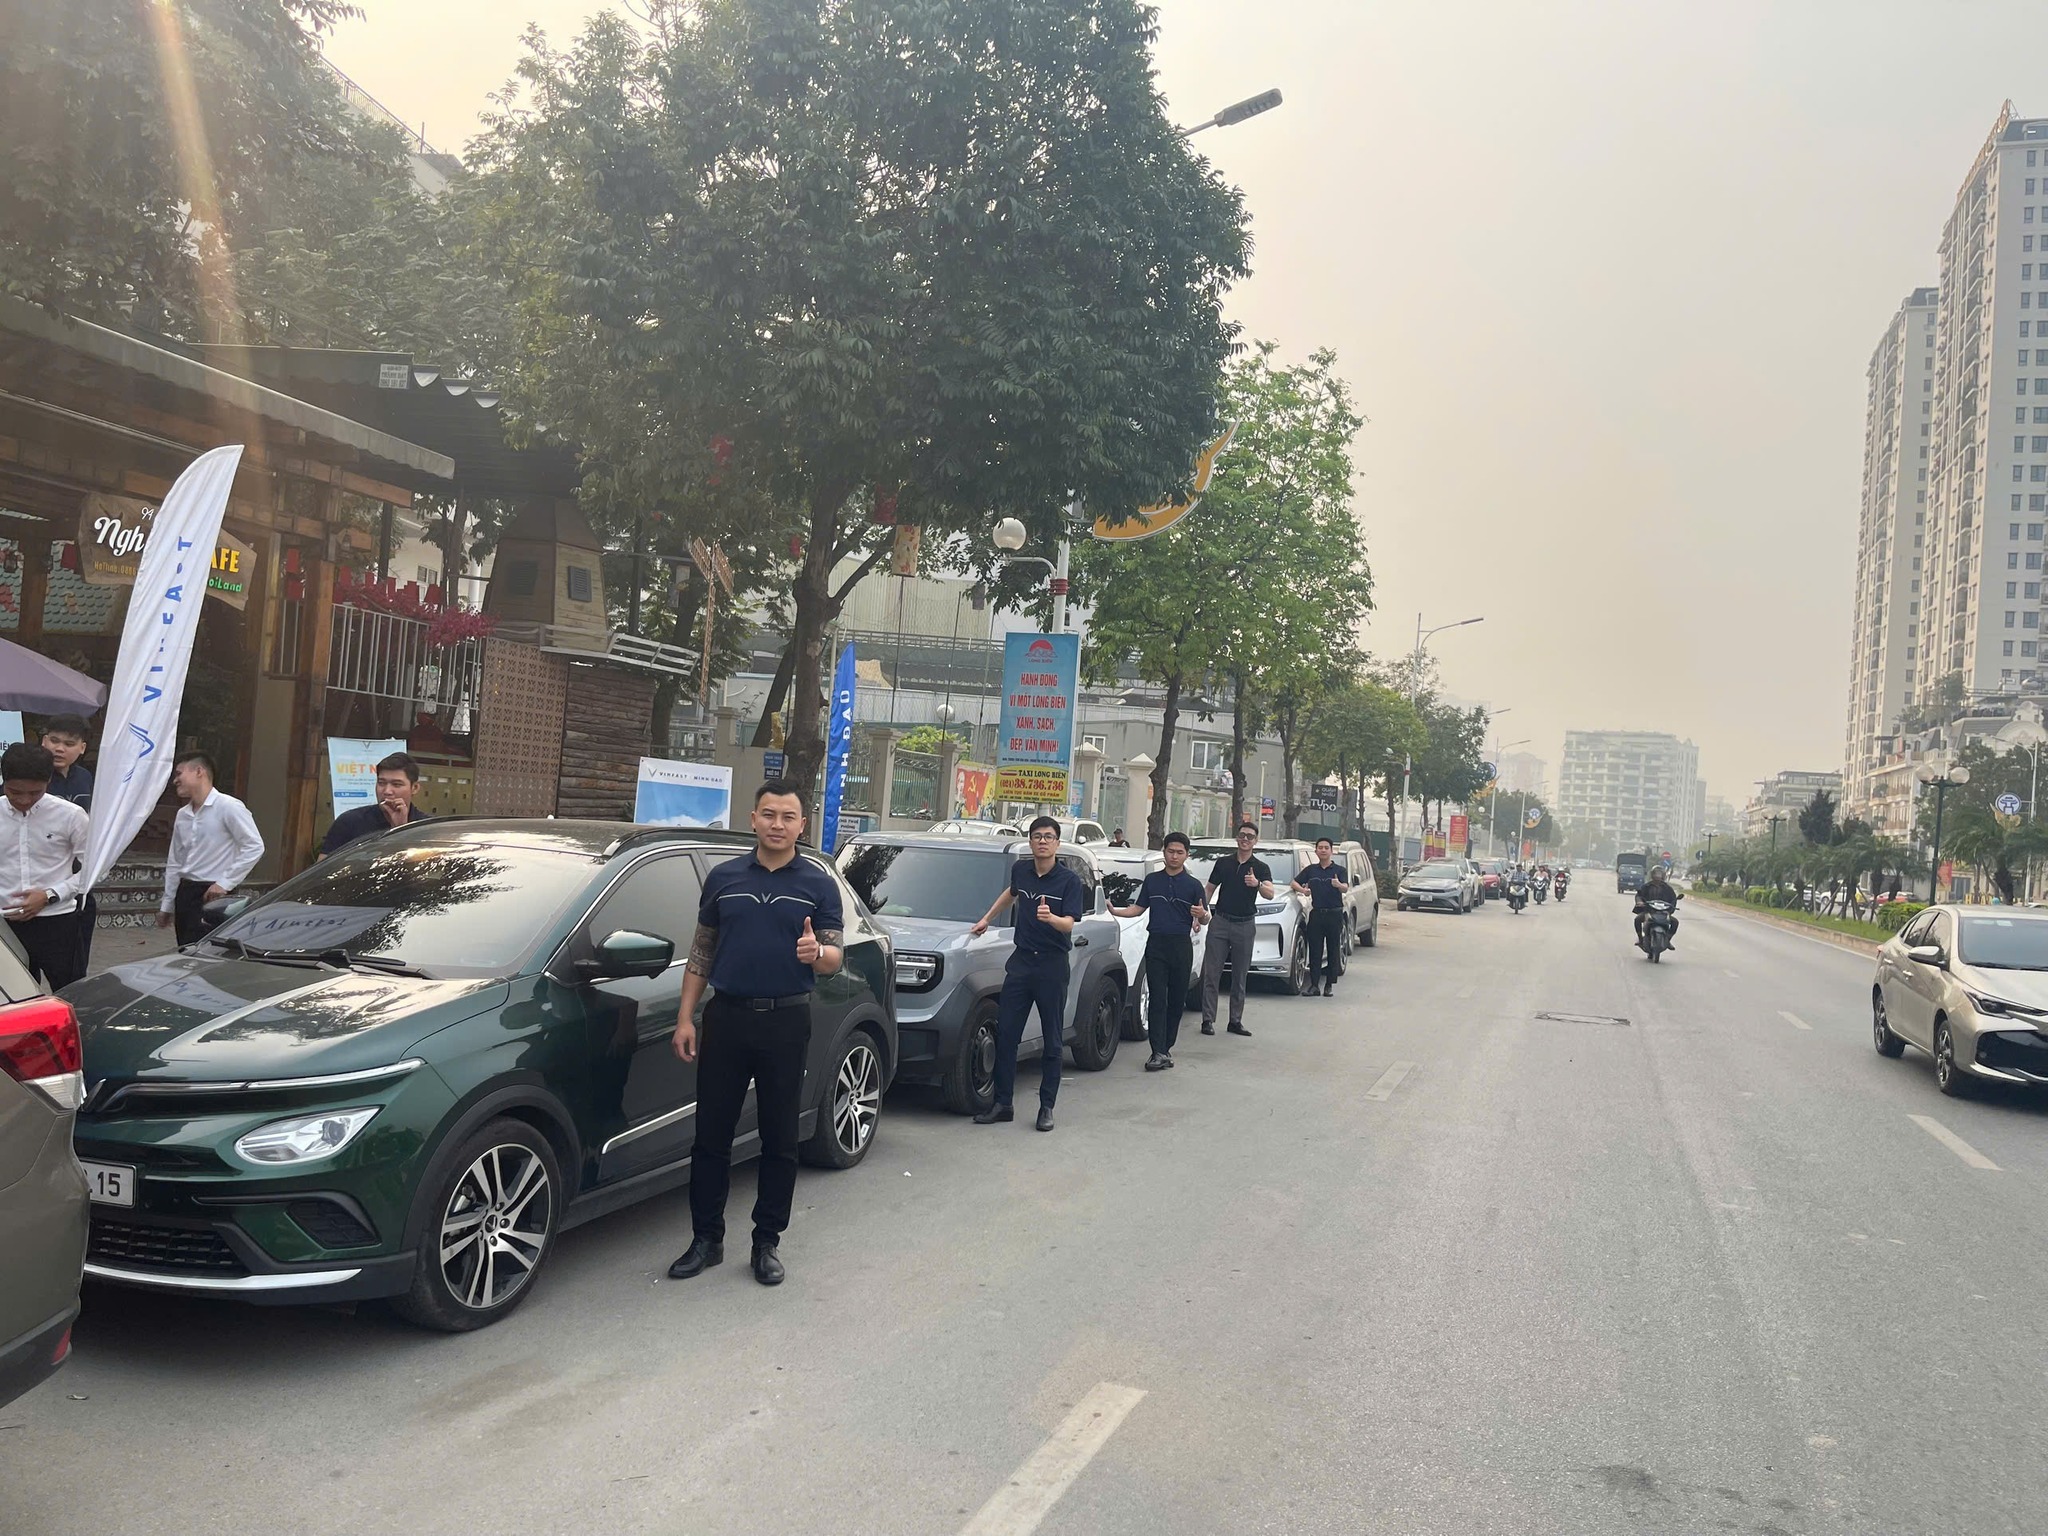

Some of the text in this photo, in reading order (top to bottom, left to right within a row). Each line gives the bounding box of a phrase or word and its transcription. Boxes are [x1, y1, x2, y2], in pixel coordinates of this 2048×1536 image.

[94, 516, 145, 557] Ngh
[210, 547, 240, 573] AFE
[208, 575, 242, 592] oiLand
[1032, 695, 1049, 708] LONG
[1039, 739, 1059, 753] MINH!
[659, 771, 688, 779] VINFAST
